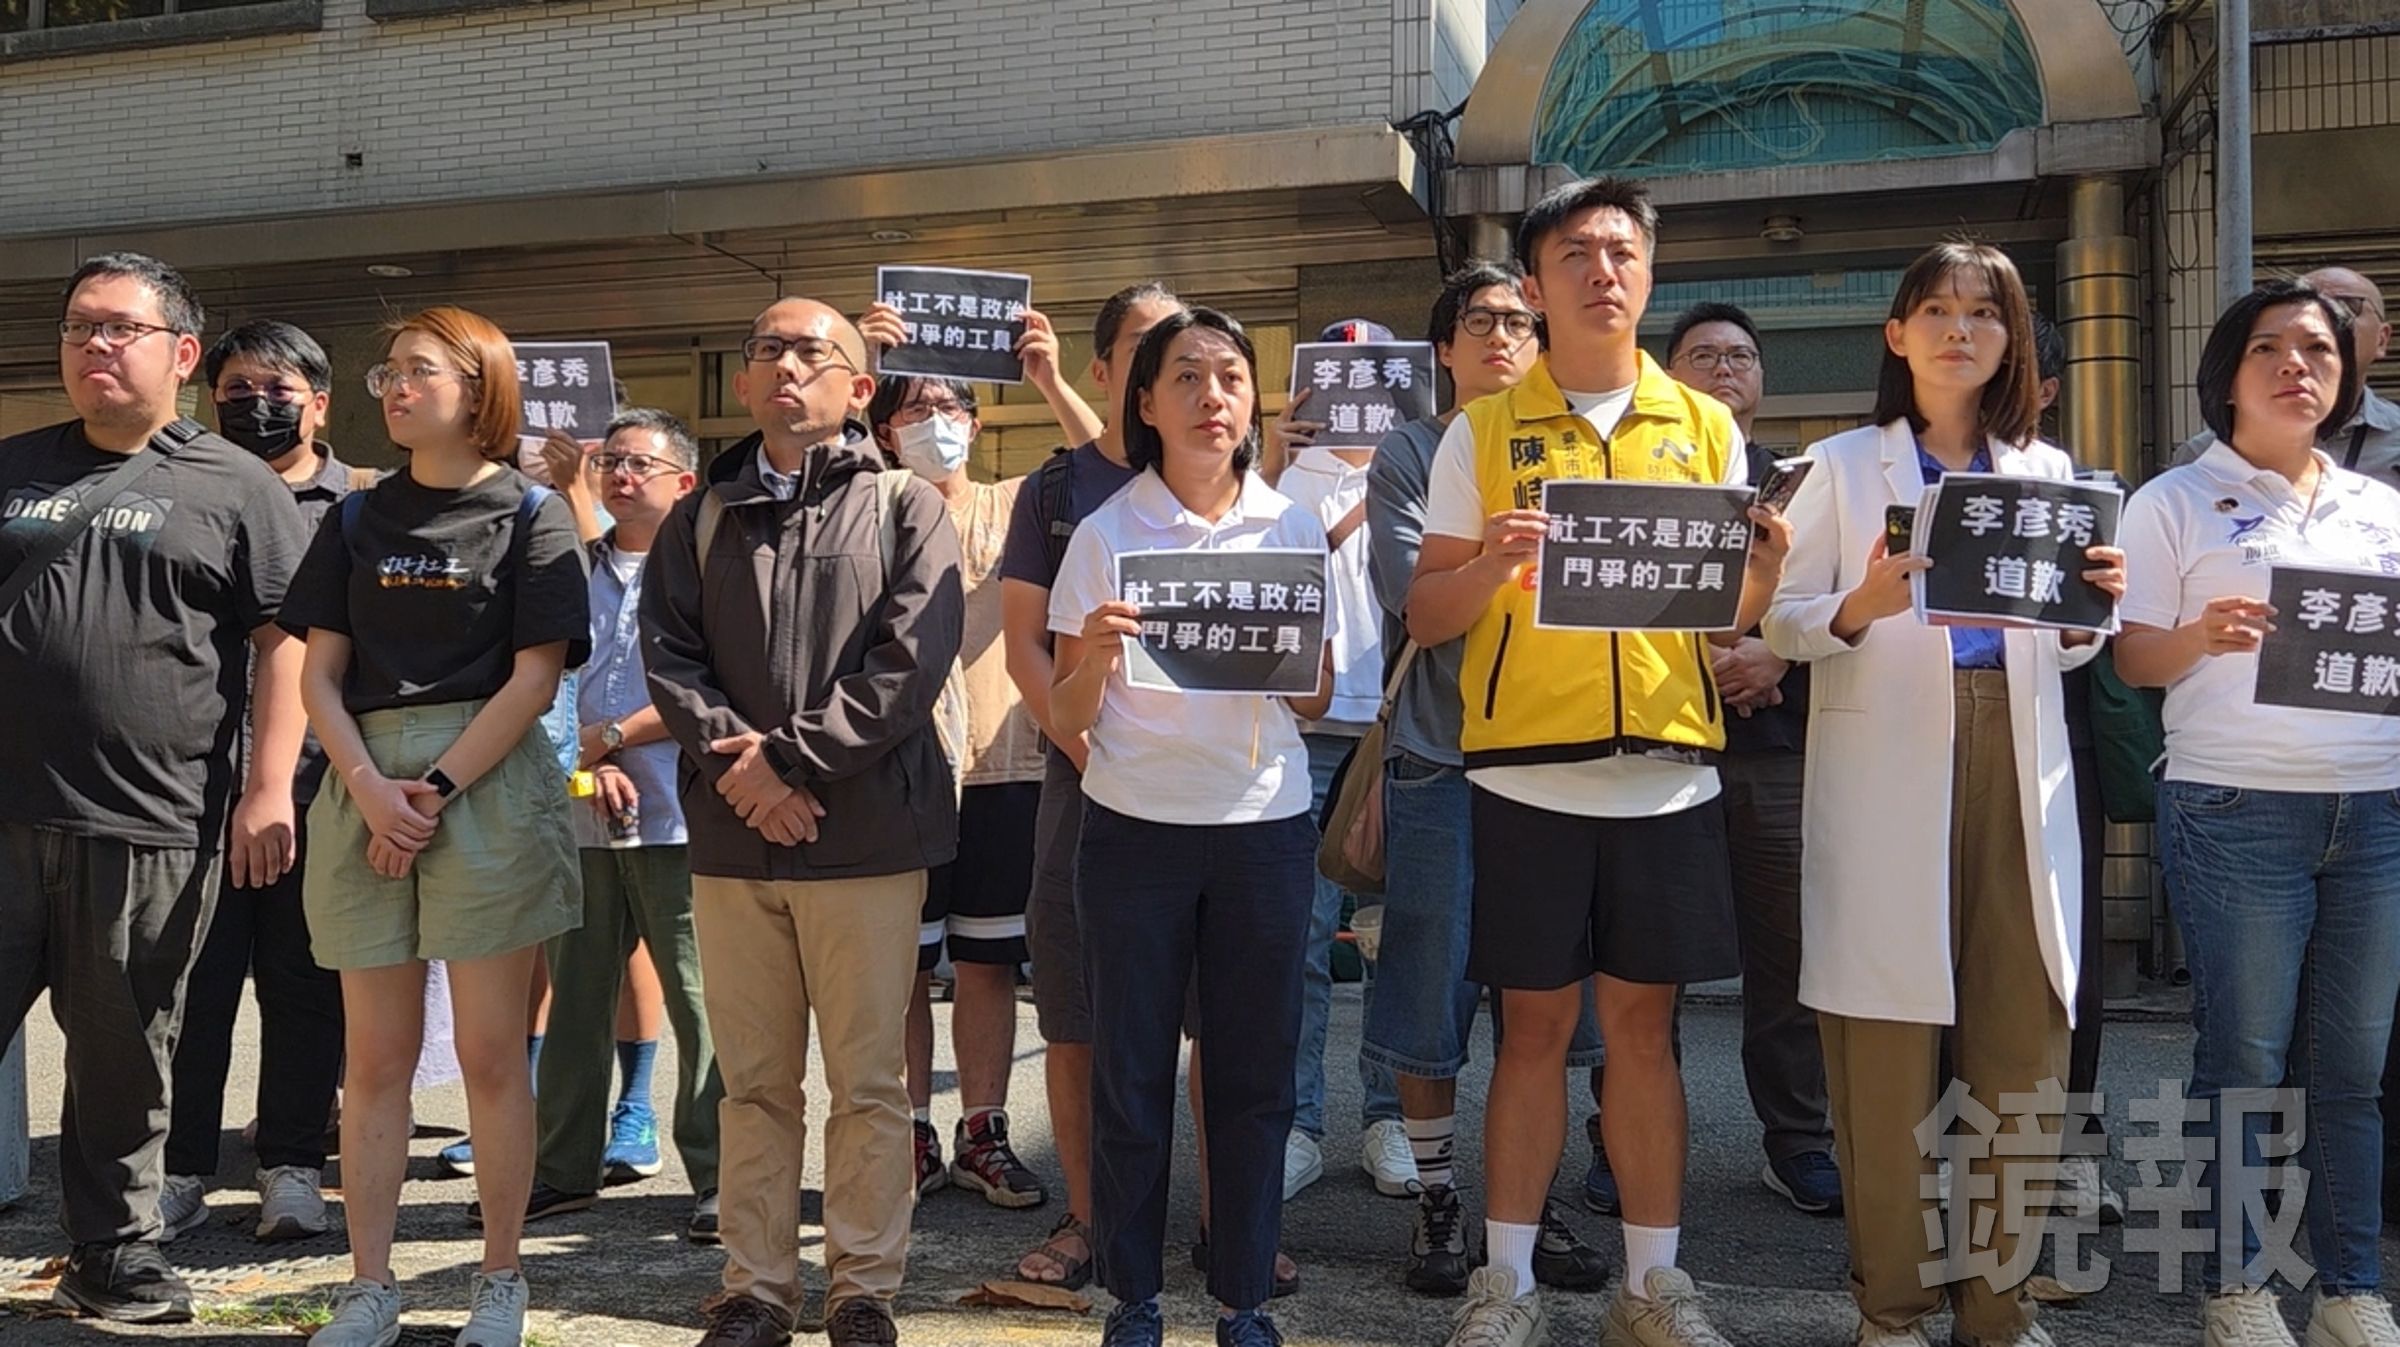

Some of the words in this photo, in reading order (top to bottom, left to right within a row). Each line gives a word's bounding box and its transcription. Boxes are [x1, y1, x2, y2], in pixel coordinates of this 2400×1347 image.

[885, 290, 1024, 321] 社工不是政治
[1312, 358, 1412, 390] 李彥秀
[523, 399, 578, 429] 道歉
[1329, 403, 1395, 433] 道歉
[3, 497, 152, 532] DIREION
[1548, 513, 1748, 550] 社工不是政治
[1961, 494, 2094, 546] 李彥秀
[1562, 556, 1725, 591] 鬥爭的工具
[1984, 556, 2065, 604] 道歉
[1124, 580, 1322, 613] 社工不是政治
[1140, 620, 1301, 654] 鬥爭的工具
[2313, 650, 2400, 696] 道歉
